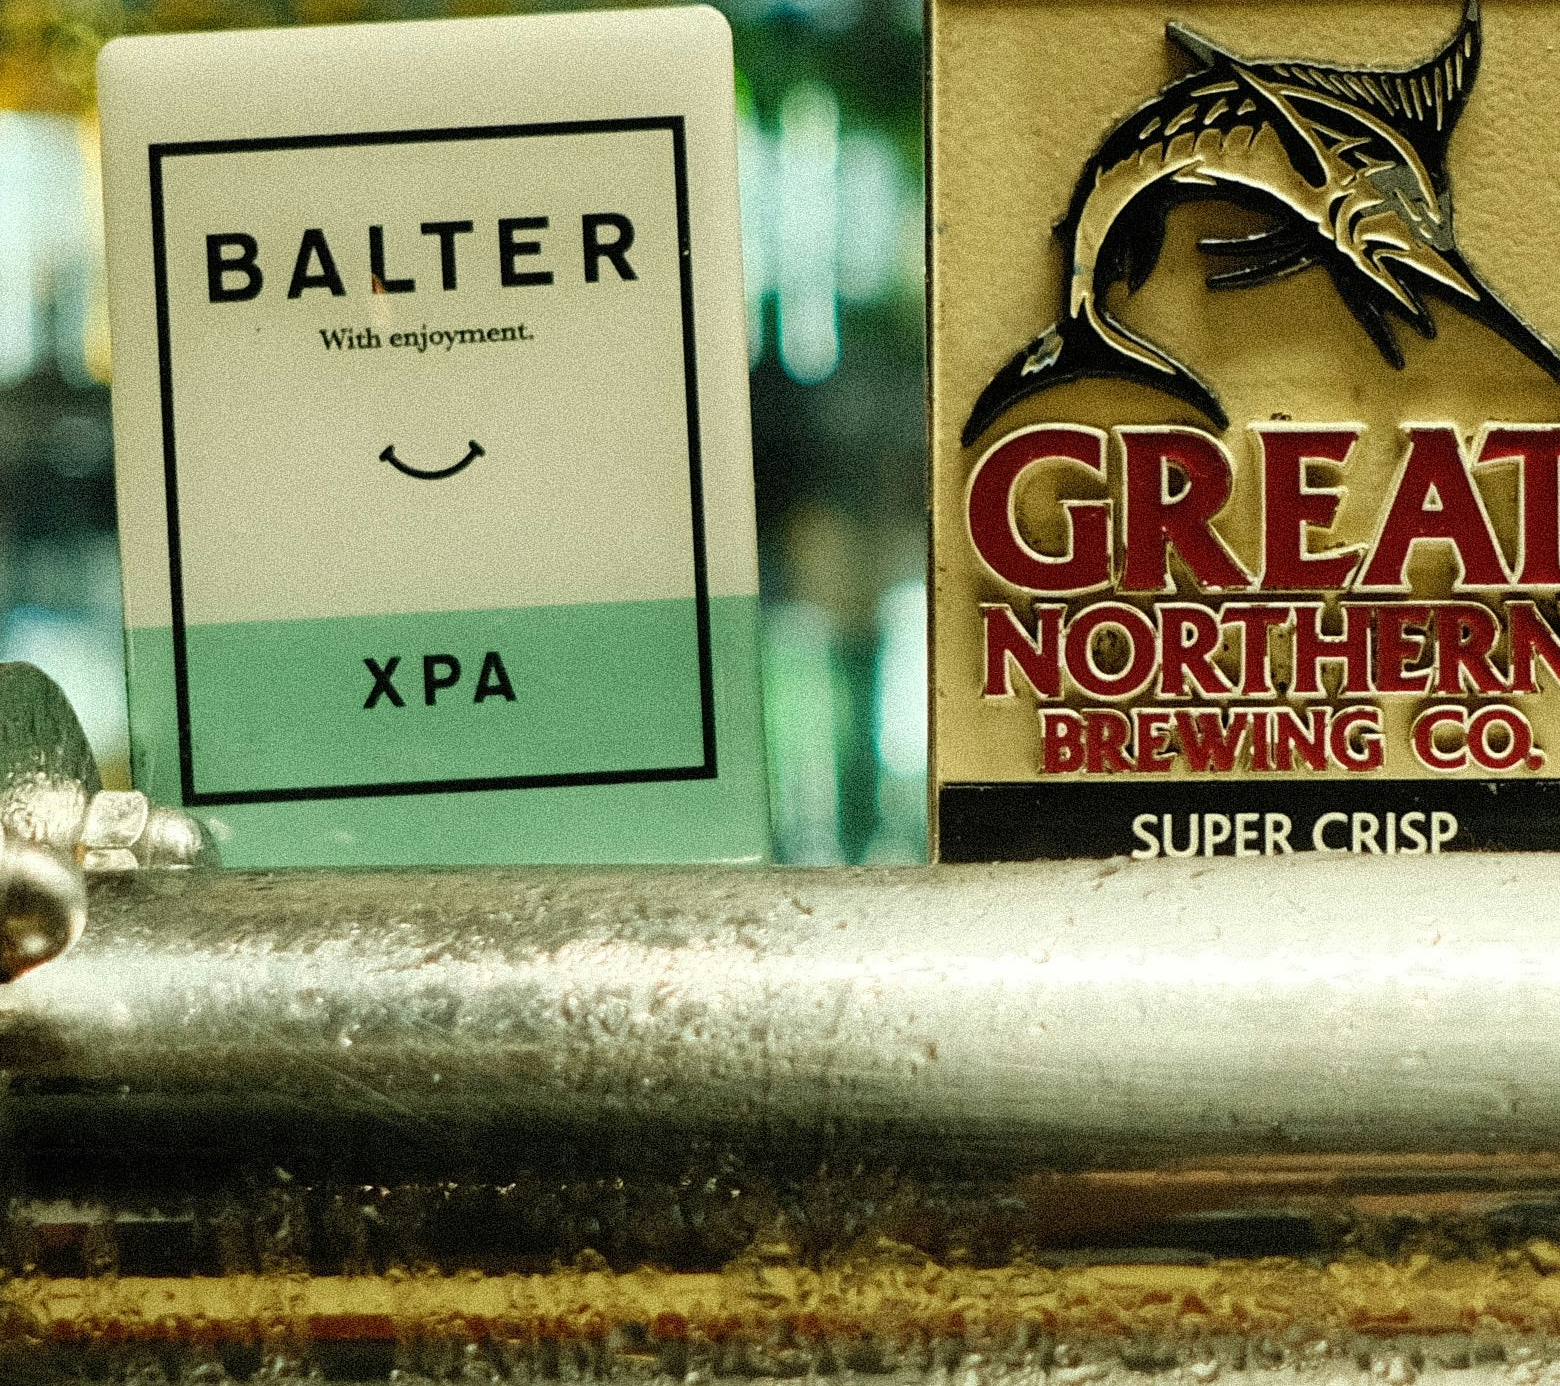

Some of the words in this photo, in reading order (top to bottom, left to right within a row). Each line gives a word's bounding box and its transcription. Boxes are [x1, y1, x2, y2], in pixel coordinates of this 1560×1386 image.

[205, 211, 638, 304] BALTER
[319, 326, 382, 351] With
[389, 322, 536, 353] enjoyment.
[362, 651, 518, 710] XPA
[1040, 706, 1384, 774] BREWING
[1410, 703, 1546, 773] CO.
[1131, 812, 1293, 860] SUPER
[1312, 811, 1458, 855] CRISP
